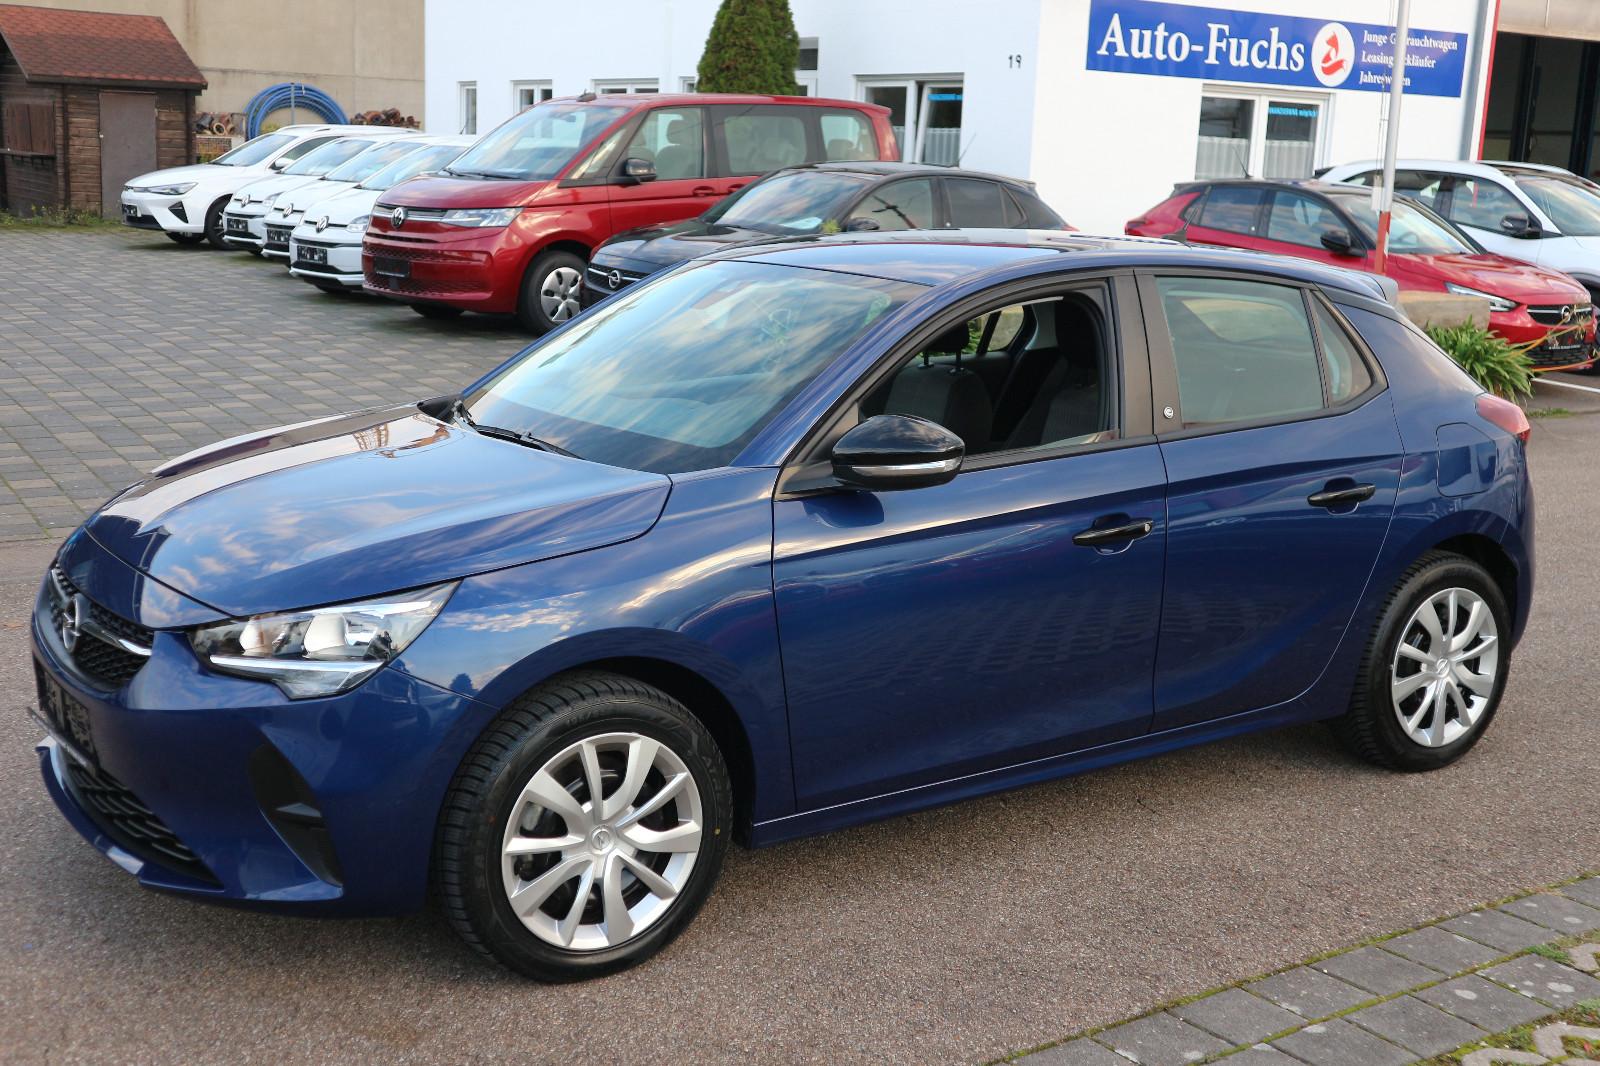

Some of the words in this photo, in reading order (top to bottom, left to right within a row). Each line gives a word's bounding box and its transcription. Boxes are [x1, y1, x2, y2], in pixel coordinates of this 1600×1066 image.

[1096, 12, 1305, 72] Auto-Fuchs
[1363, 30, 1388, 46] Junge
[1391, 33, 1458, 52] Grauchtwagen
[1008, 54, 1022, 69] 19
[1362, 51, 1436, 68] Leasingckläufer
[1359, 71, 1411, 86] Jahreswen
